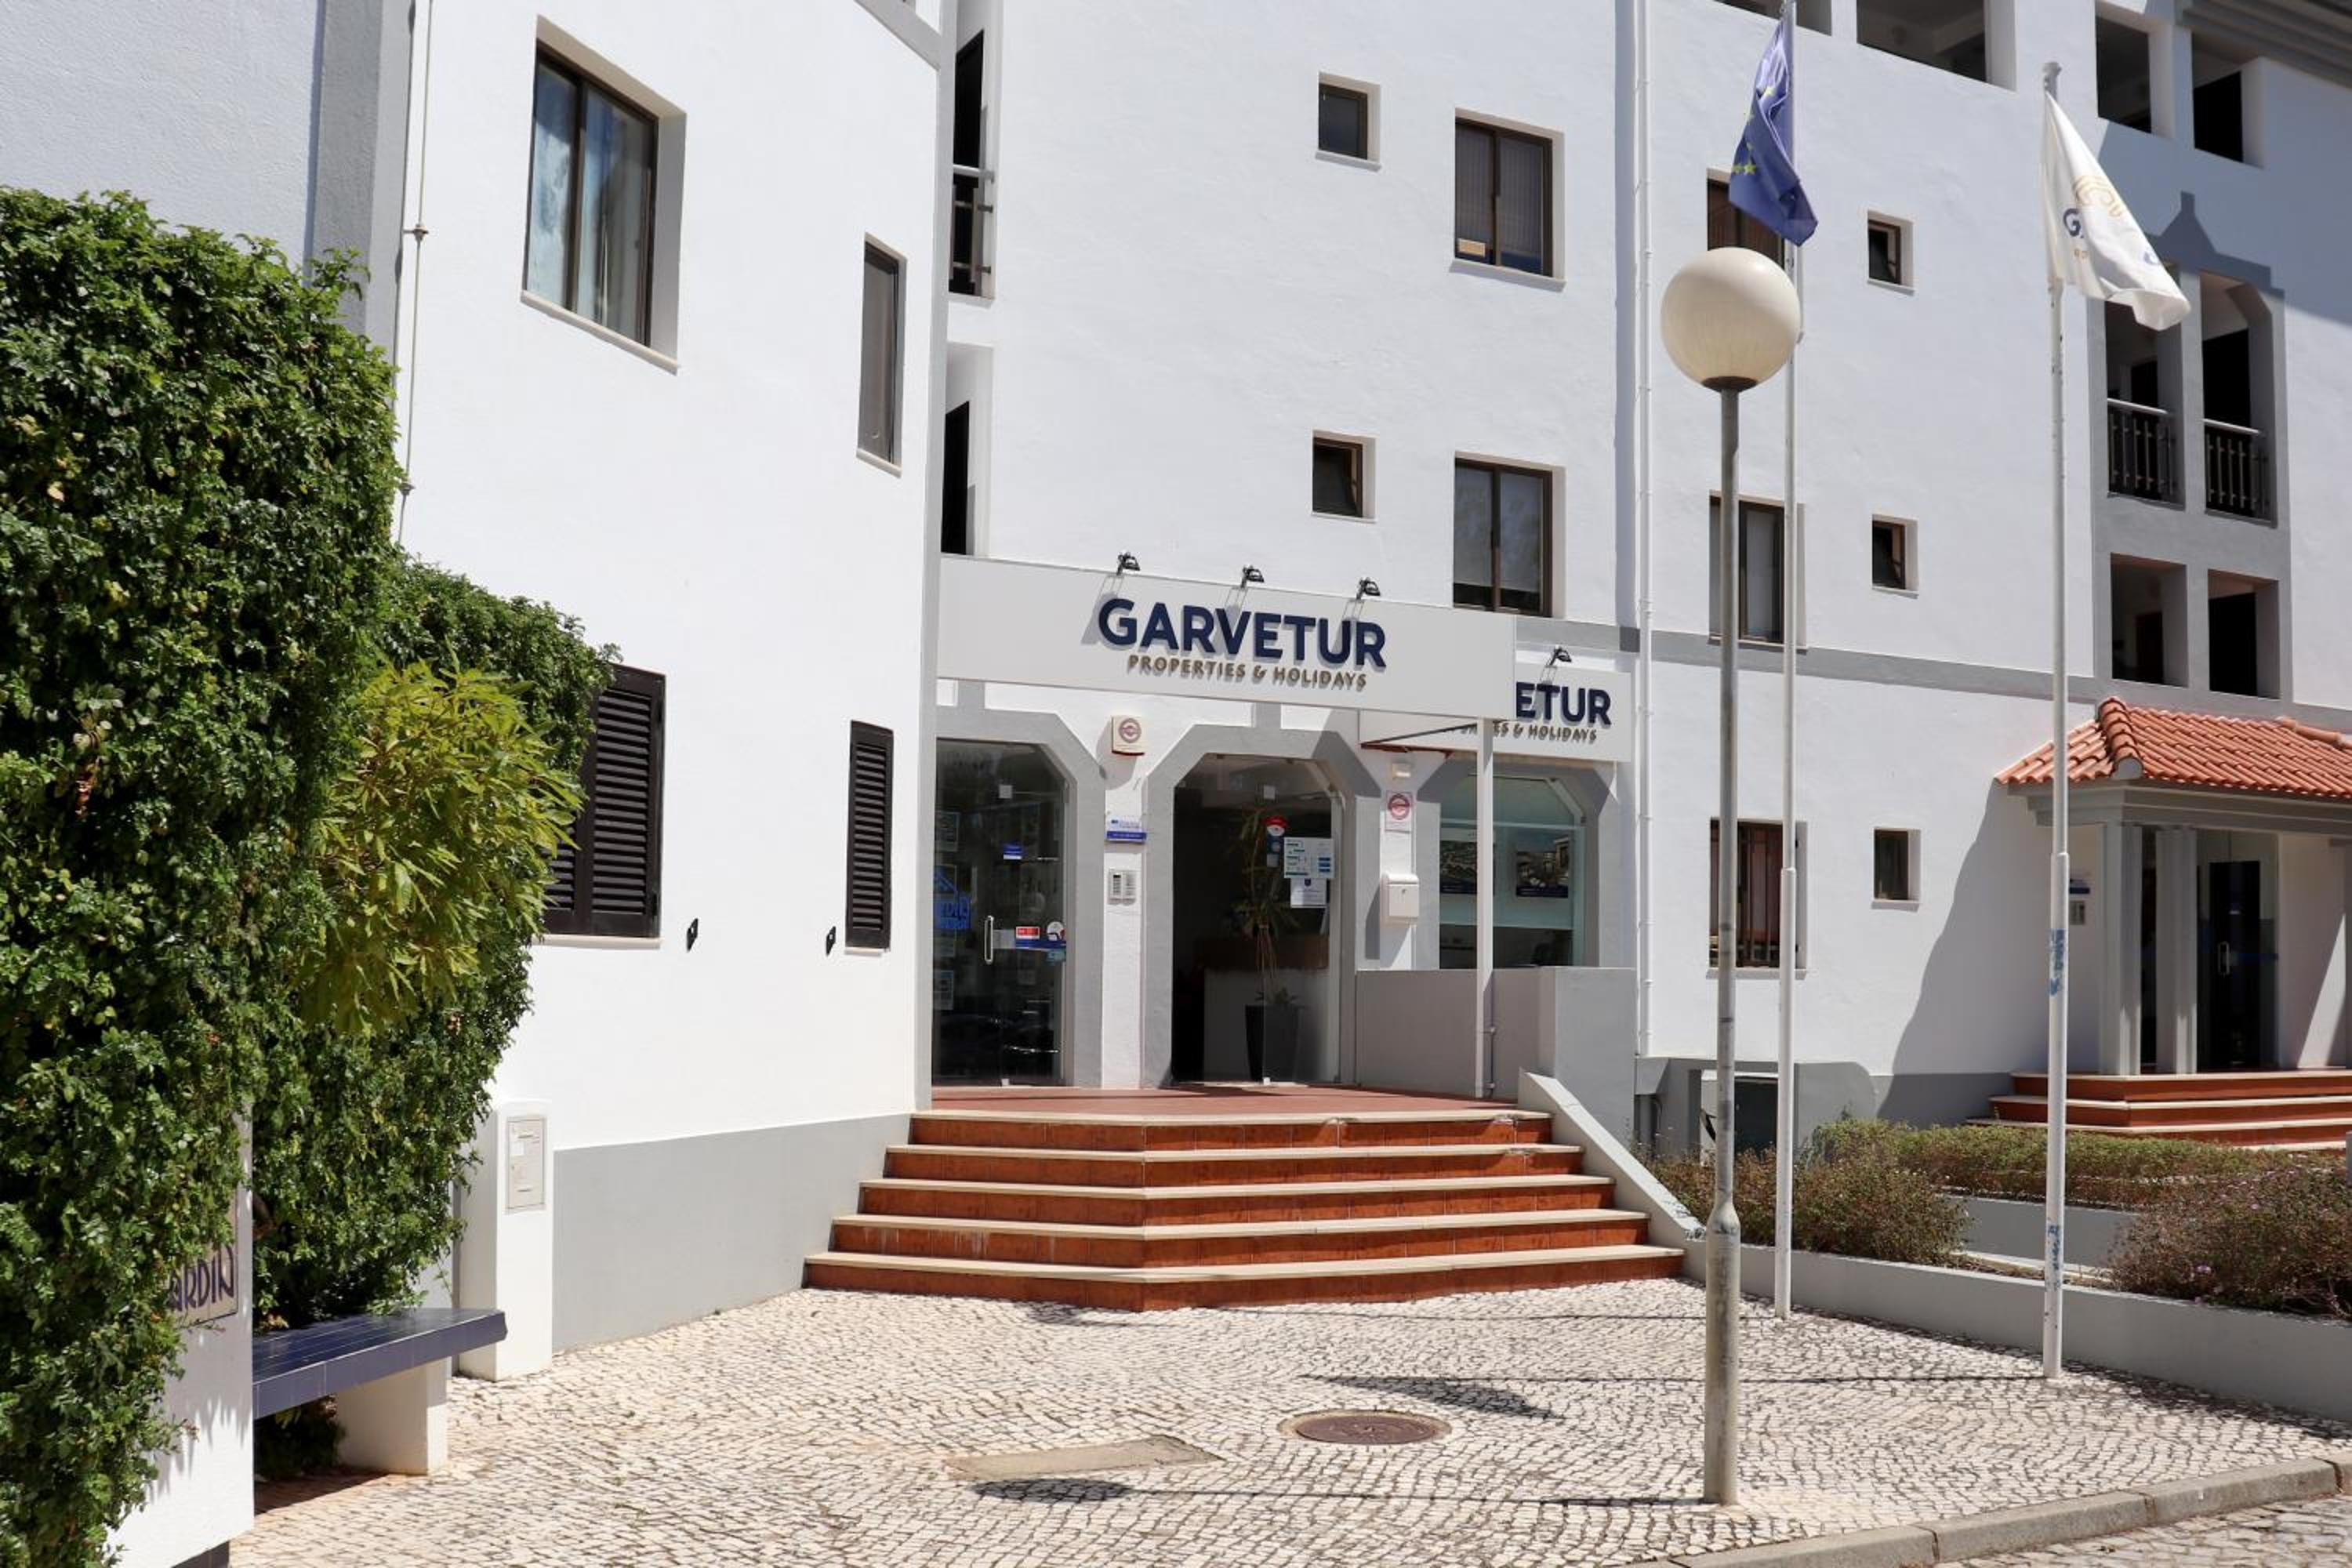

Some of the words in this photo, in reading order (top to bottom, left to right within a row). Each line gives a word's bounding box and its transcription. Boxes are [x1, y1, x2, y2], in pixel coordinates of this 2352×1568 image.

[1098, 598, 1387, 667] GARVETUR
[1127, 654, 1247, 680] PROPERTIES
[1253, 665, 1268, 680] &
[1272, 666, 1367, 690] HOLIDAYS
[1515, 681, 1612, 725] ETUR
[1513, 723, 1524, 735] &
[1528, 725, 1597, 742] HOLIDAYS
